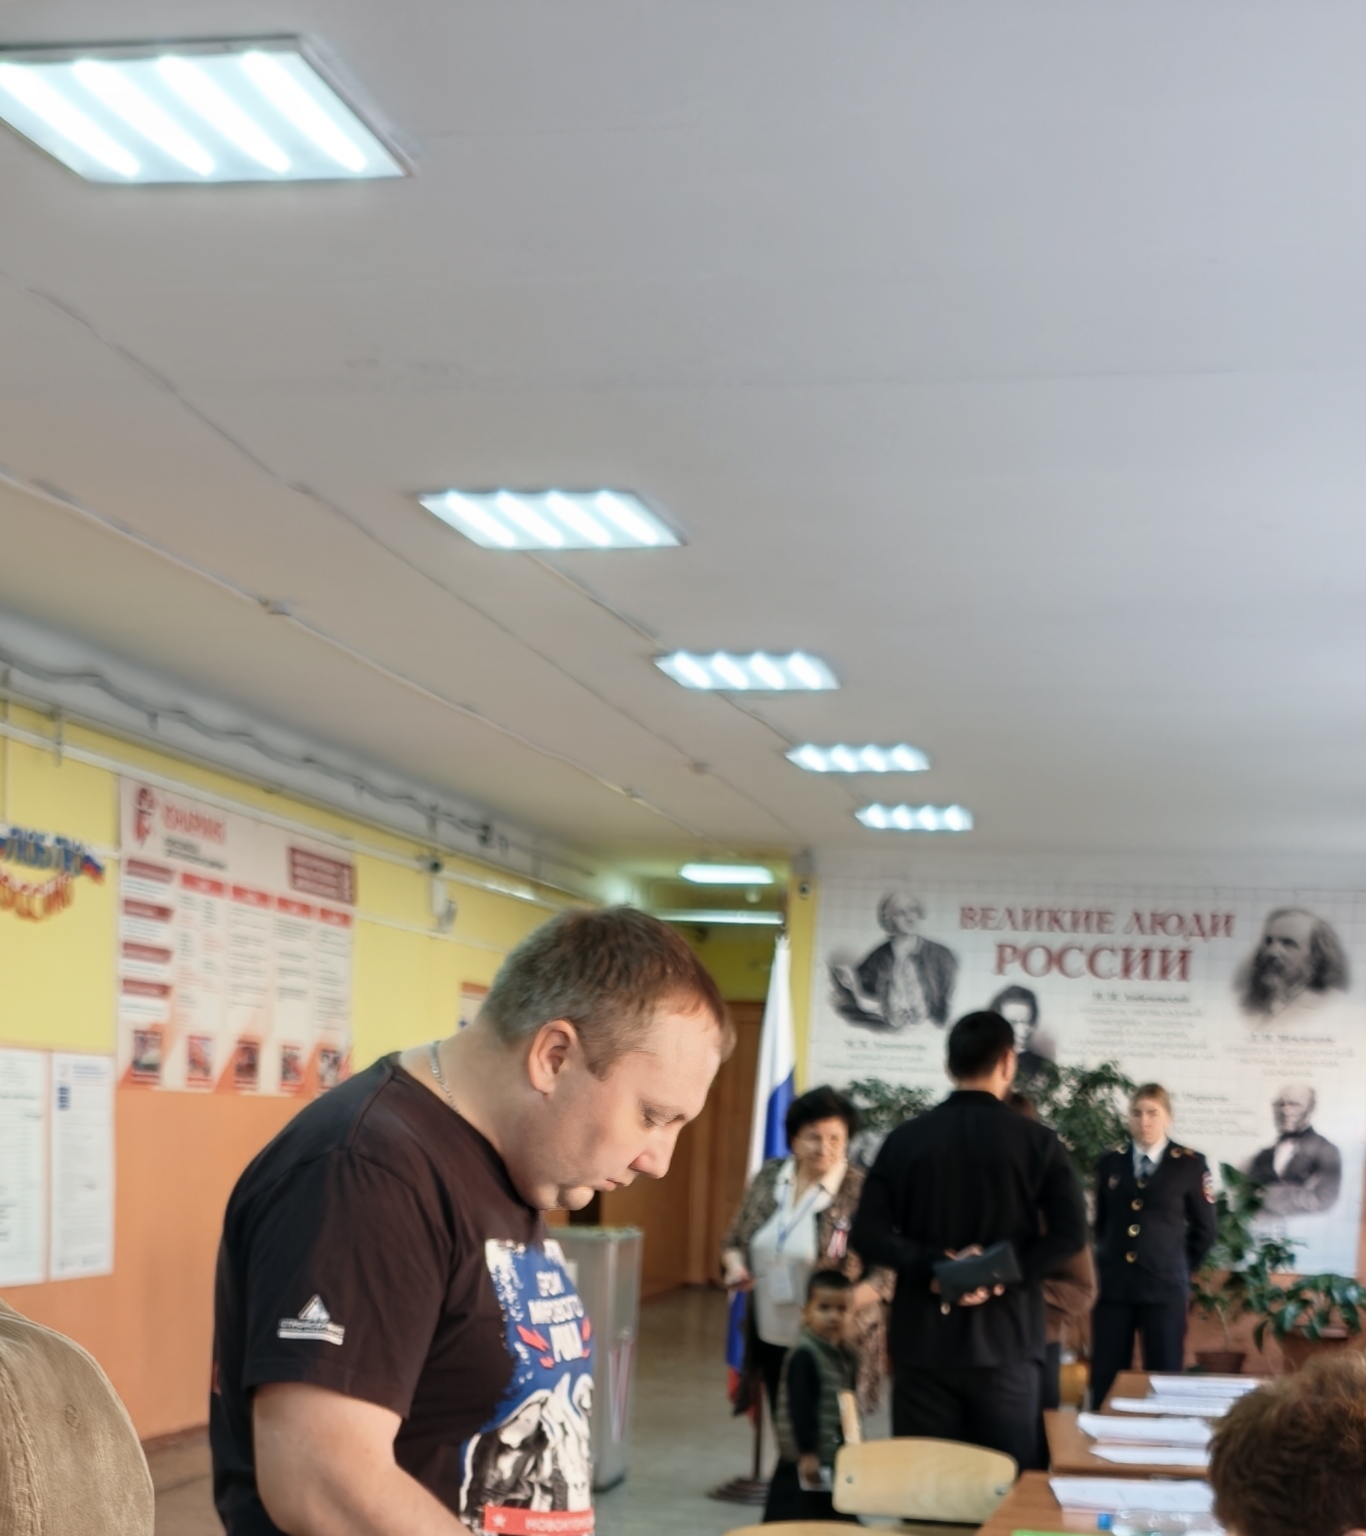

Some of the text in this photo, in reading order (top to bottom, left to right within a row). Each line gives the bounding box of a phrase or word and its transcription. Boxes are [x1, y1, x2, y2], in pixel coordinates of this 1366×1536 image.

[959, 906, 1237, 942] ВЕЛИКИЕ ЛЮДИ
[994, 943, 1193, 982] РОССИИ
